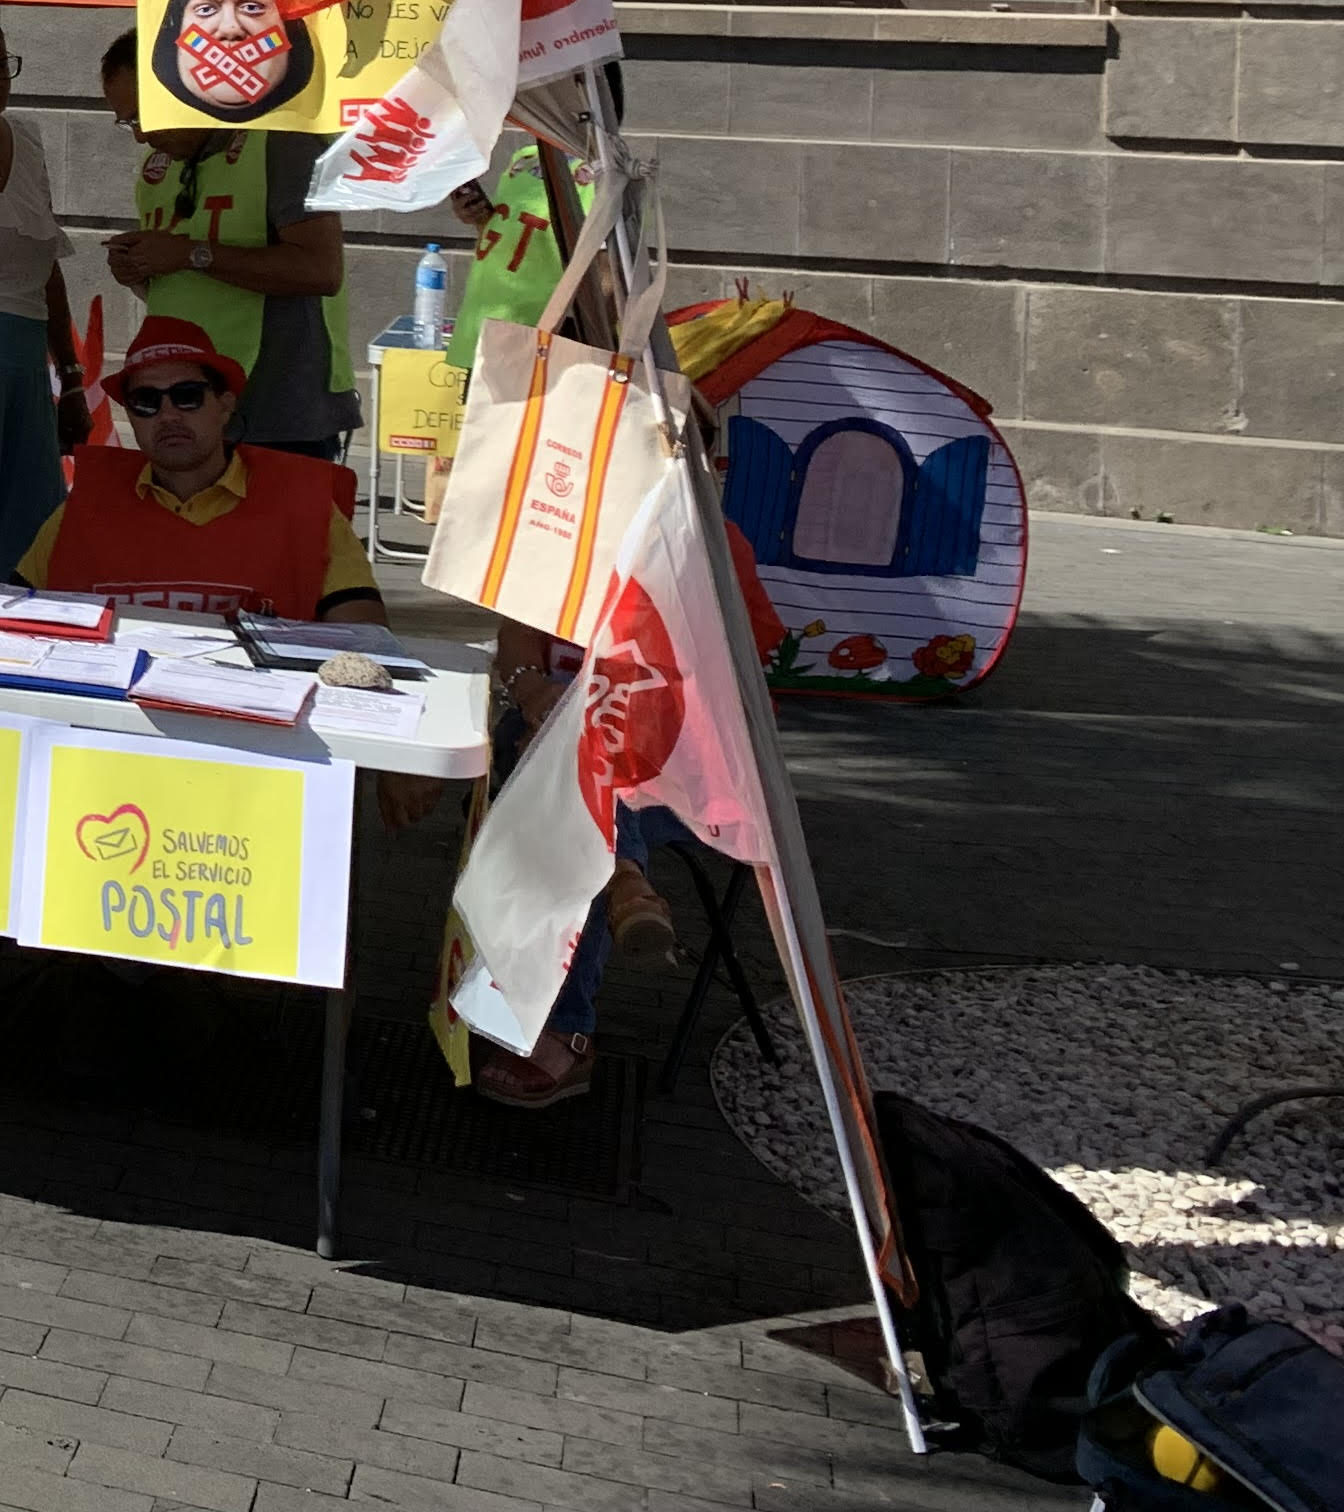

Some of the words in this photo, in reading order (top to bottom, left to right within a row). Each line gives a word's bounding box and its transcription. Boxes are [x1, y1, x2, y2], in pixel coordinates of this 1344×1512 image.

[347, 2, 373, 20] NO
[387, 3, 420, 20] LES
[344, 40, 358, 59] A
[529, 498, 576, 525] ESPAÑA
[162, 828, 250, 861] SALVEMOS
[152, 860, 170, 879] EL
[176, 861, 252, 886] SERVICIO
[102, 880, 253, 950] POSTAL
